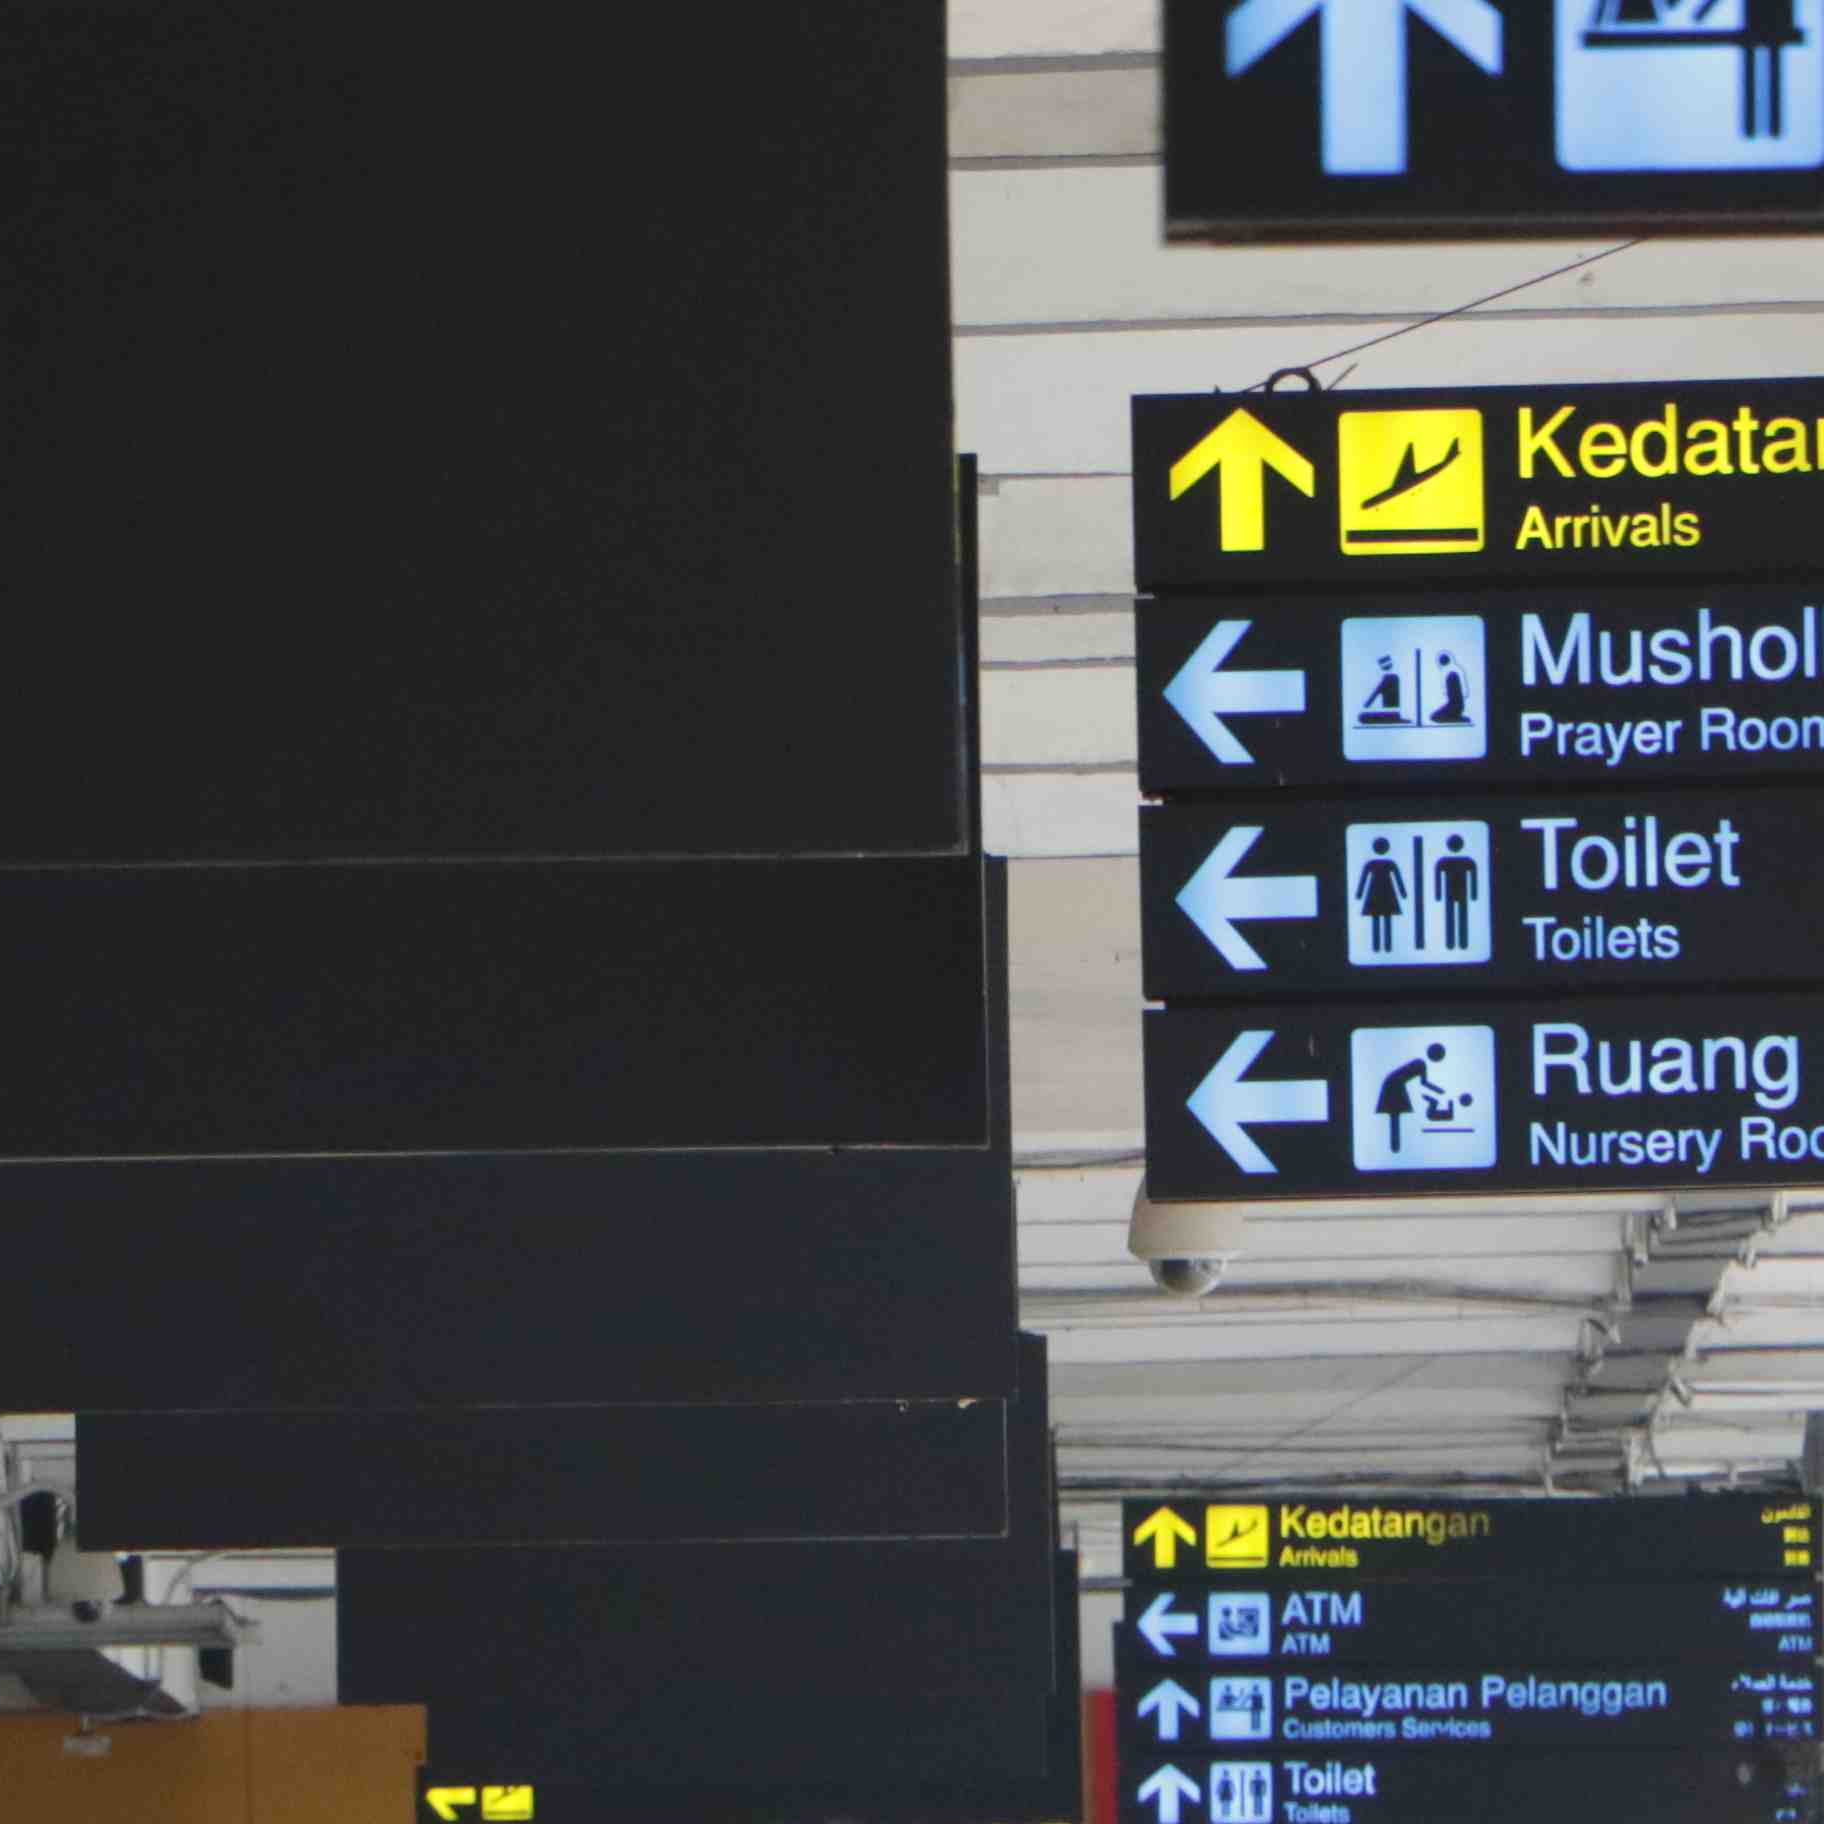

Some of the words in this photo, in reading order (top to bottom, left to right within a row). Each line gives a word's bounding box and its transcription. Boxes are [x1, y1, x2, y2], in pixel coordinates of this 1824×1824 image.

[1515, 502, 1701, 550] Arrivals
[1520, 712, 1684, 763] Prayer
[1520, 815, 1742, 891] Toilet
[1522, 915, 1681, 961] Toilets
[1532, 1022, 1800, 1112] Ruang
[1530, 1121, 1723, 1174] Nursery
[1280, 1505, 1490, 1545] Kedatangan
[1279, 1545, 1359, 1568] Arrivals
[1280, 1591, 1364, 1627] ATM
[1280, 1632, 1332, 1655] ATM
[1284, 1676, 1469, 1716] Pelayanan
[1480, 1674, 1668, 1716] Pelanggan
[1282, 1716, 1397, 1740] Customers
[1400, 1716, 1493, 1740] Services
[1283, 1761, 1377, 1798] Toilet
[1283, 1801, 1351, 1824] Toilets
